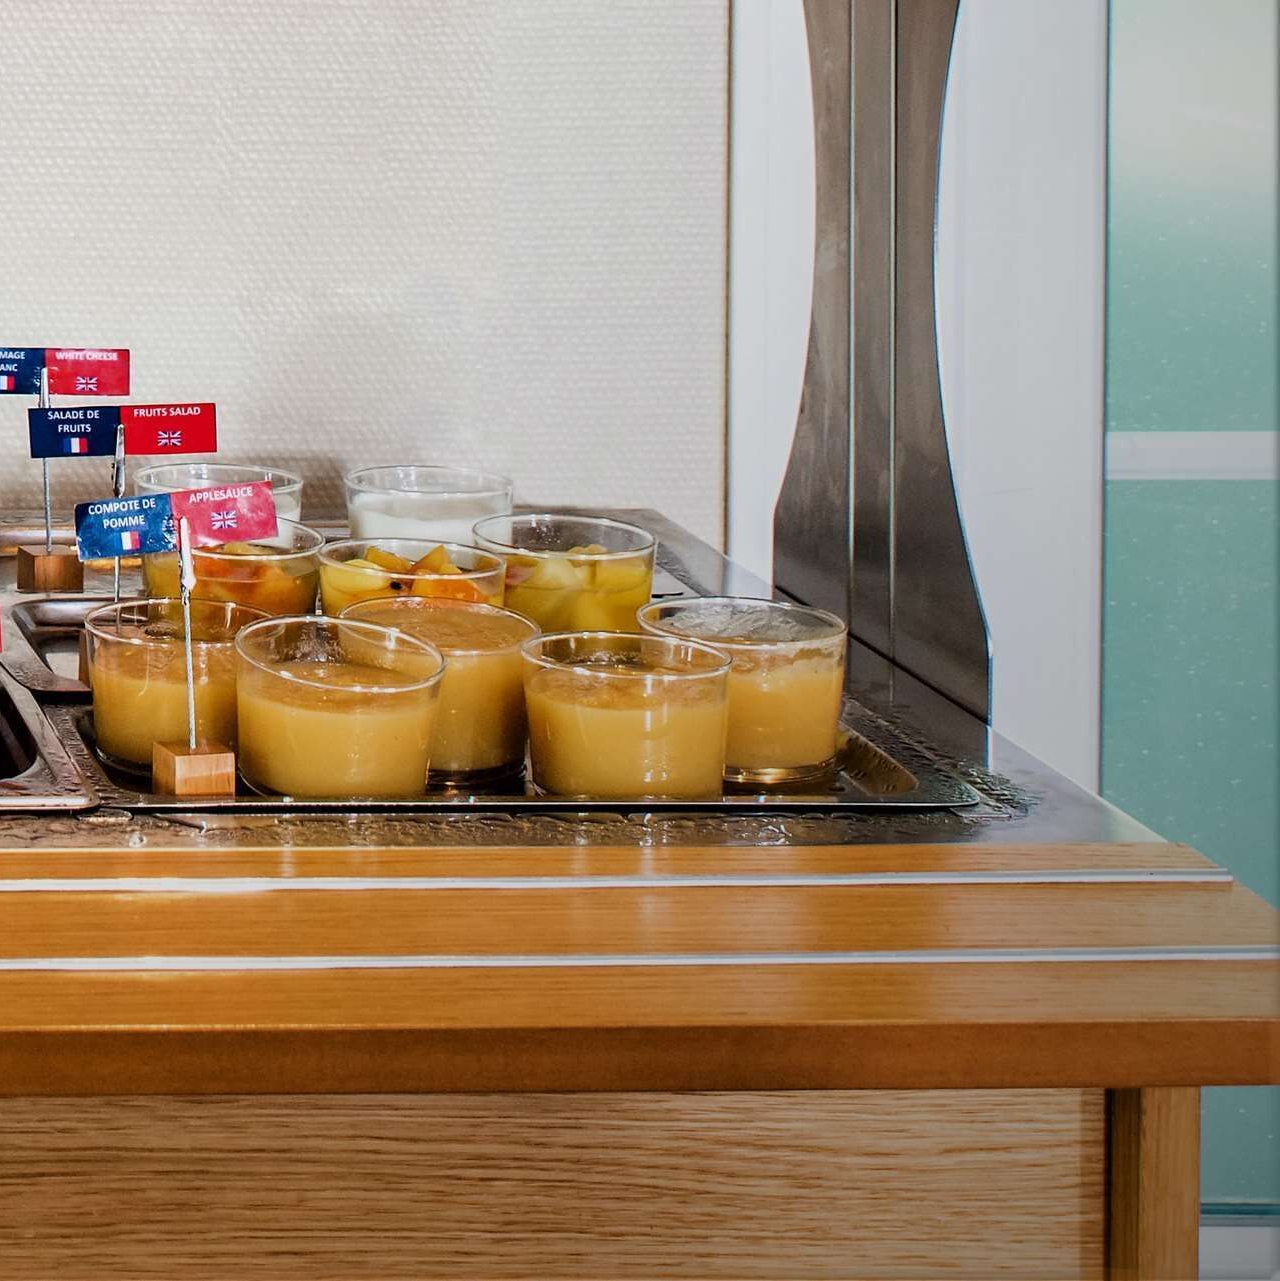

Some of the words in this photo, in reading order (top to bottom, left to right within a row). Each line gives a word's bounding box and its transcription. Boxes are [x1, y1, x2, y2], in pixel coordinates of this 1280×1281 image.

[55, 351, 83, 360] WHITE
[85, 351, 119, 360] CHEESE
[48, 411, 85, 420] SALADE
[87, 410, 100, 419] DE
[133, 408, 168, 417] FRUITS
[169, 407, 201, 416] SALAD
[58, 424, 92, 433] FRUITS
[189, 486, 254, 503] APPLESAUCE
[88, 501, 140, 515] COMPOTE
[142, 498, 156, 508] DE
[103, 515, 146, 529] POMME
